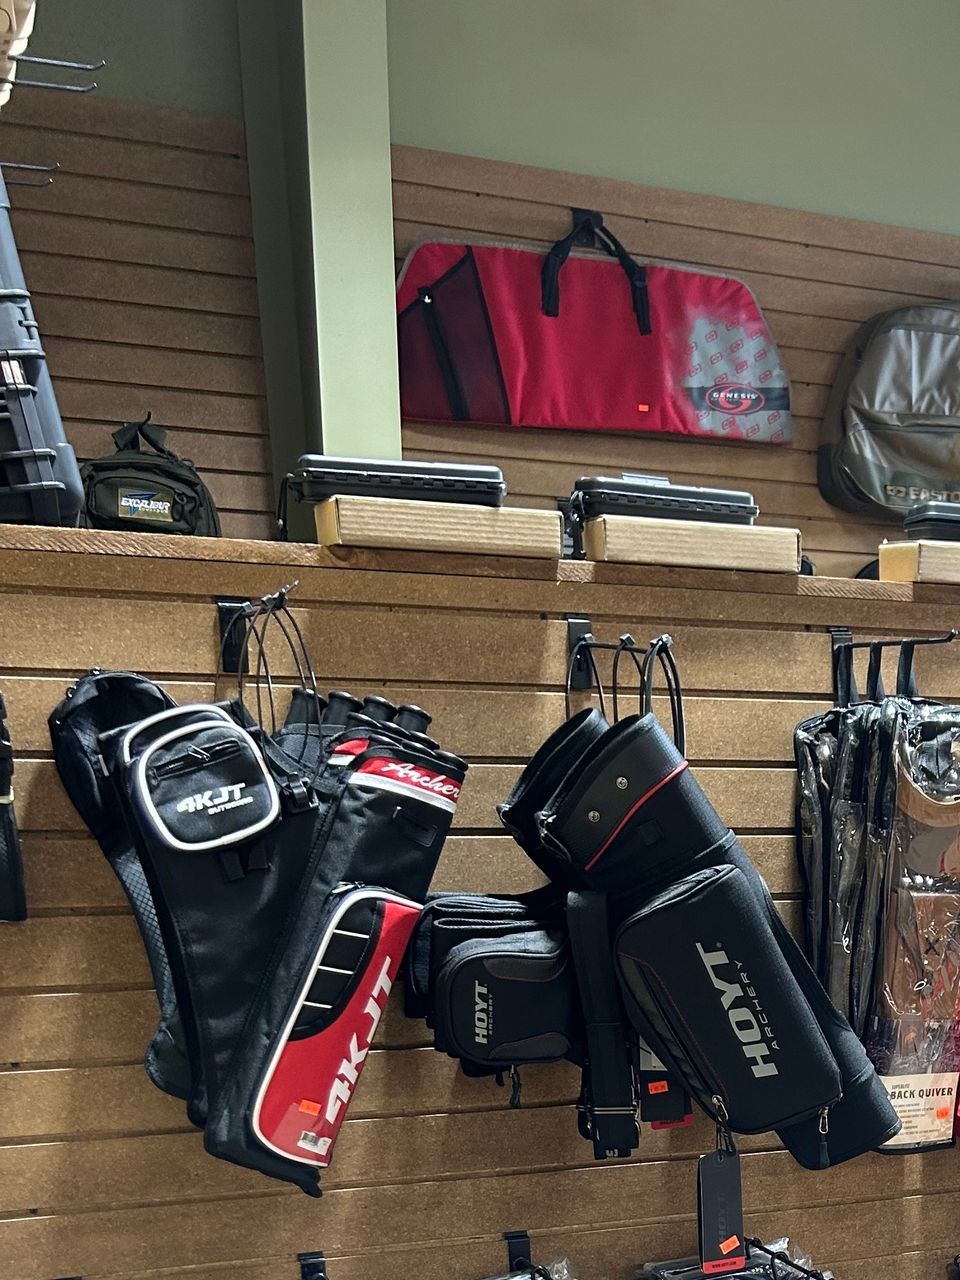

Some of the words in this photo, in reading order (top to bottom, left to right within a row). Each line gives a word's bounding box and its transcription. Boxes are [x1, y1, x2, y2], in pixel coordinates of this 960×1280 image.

[712, 392, 758, 400] GENESIS
[121, 497, 171, 512] EXCALIBUR
[176, 782, 246, 813] 4KJT
[475, 980, 488, 1044] HOYT
[695, 942, 779, 1078] HOYT
[734, 959, 781, 1050] ARCHERY
[325, 955, 393, 1125] 4KJT
[890, 1090, 915, 1100] BACK
[918, 1087, 954, 1099] QUIVER
